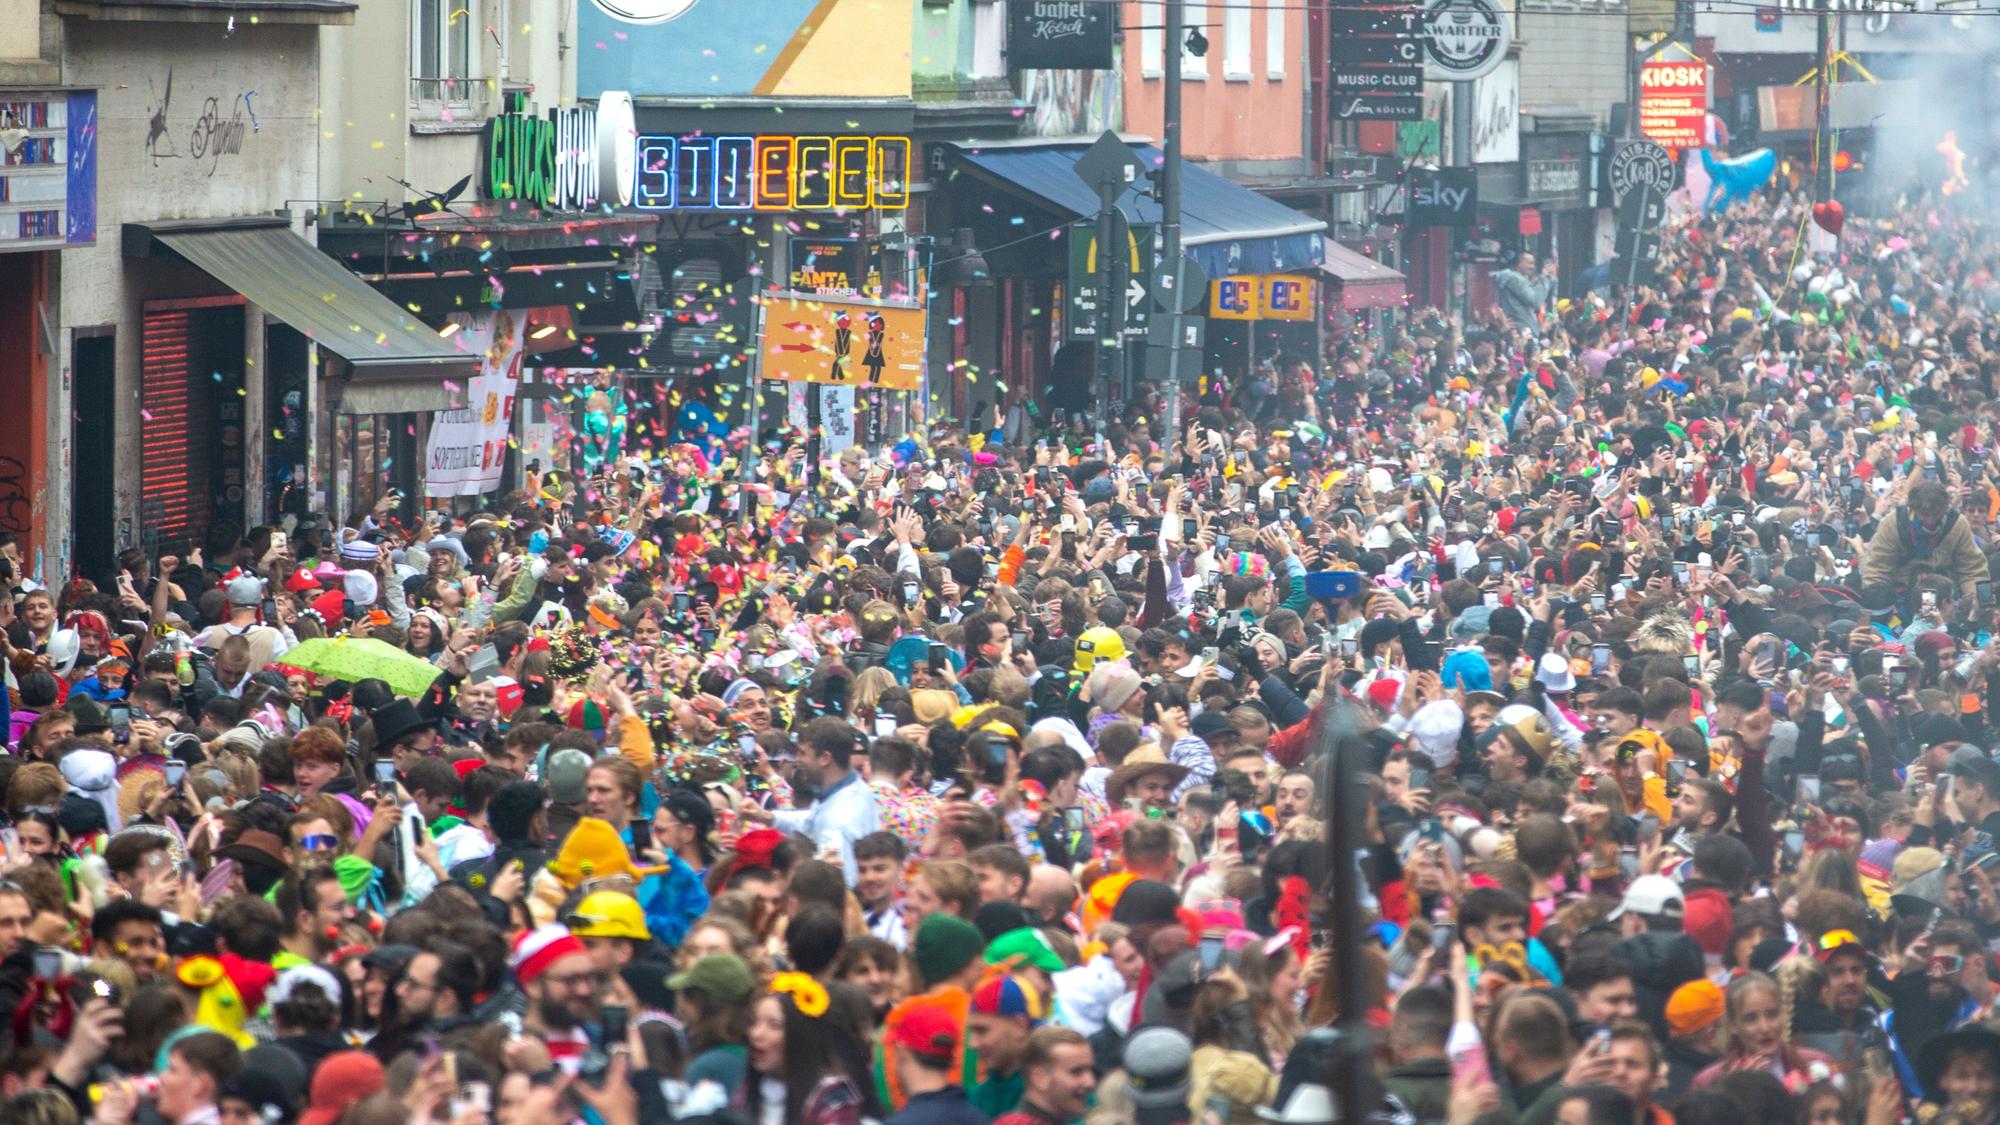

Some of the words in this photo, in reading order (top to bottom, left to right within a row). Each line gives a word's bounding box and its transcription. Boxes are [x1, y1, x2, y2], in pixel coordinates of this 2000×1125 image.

[1032, 18, 1086, 40] Kölsch
[1337, 75, 1380, 86] MUSIC
[1382, 75, 1417, 86] CLUB
[1641, 66, 1704, 88] KIOSK
[641, 145, 903, 198] STIEFEL
[1414, 180, 1470, 213] sky
[790, 271, 850, 289] FANTA
